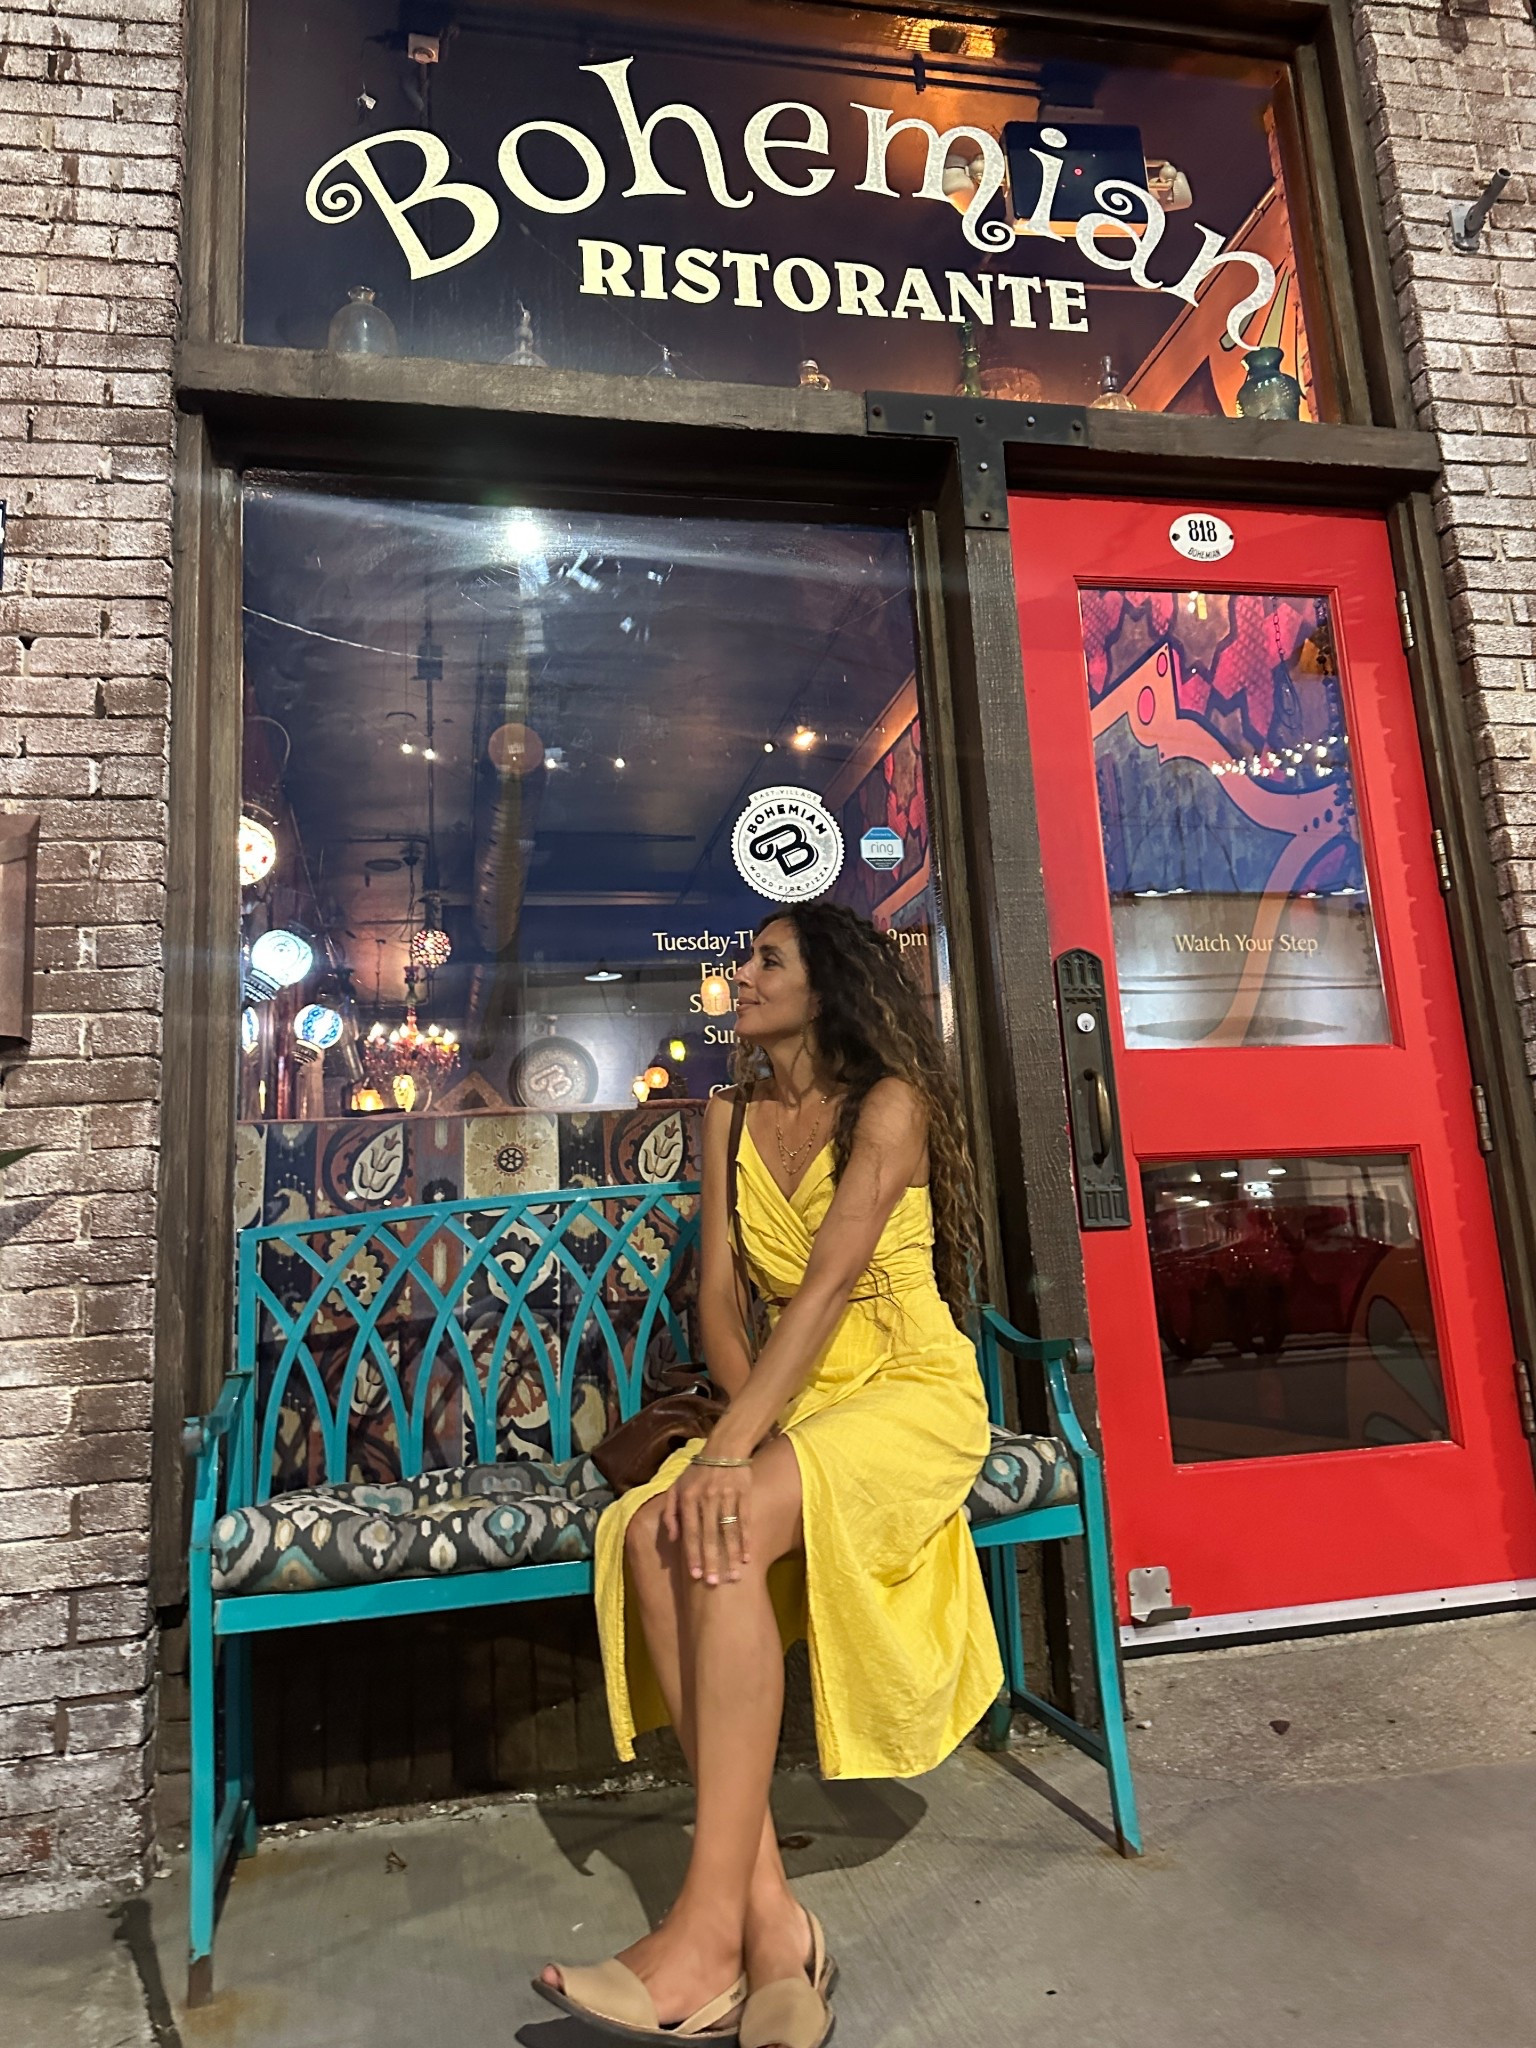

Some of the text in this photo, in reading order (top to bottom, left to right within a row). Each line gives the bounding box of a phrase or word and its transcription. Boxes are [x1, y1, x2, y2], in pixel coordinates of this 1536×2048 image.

[305, 56, 1275, 351] Bohemian
[578, 239, 1089, 332] RISTORANTE
[1187, 519, 1218, 542] 818
[1187, 547, 1221, 559] BOHEMIAN
[754, 789, 818, 801] EAST VILLAGE
[747, 804, 827, 834] BOHEMIAN
[870, 841, 894, 856] ring
[750, 864, 829, 892] WOOD FIRE PIZZA
[1174, 933, 1319, 958] Watch Your Step
[701, 960, 743, 981] Frid
